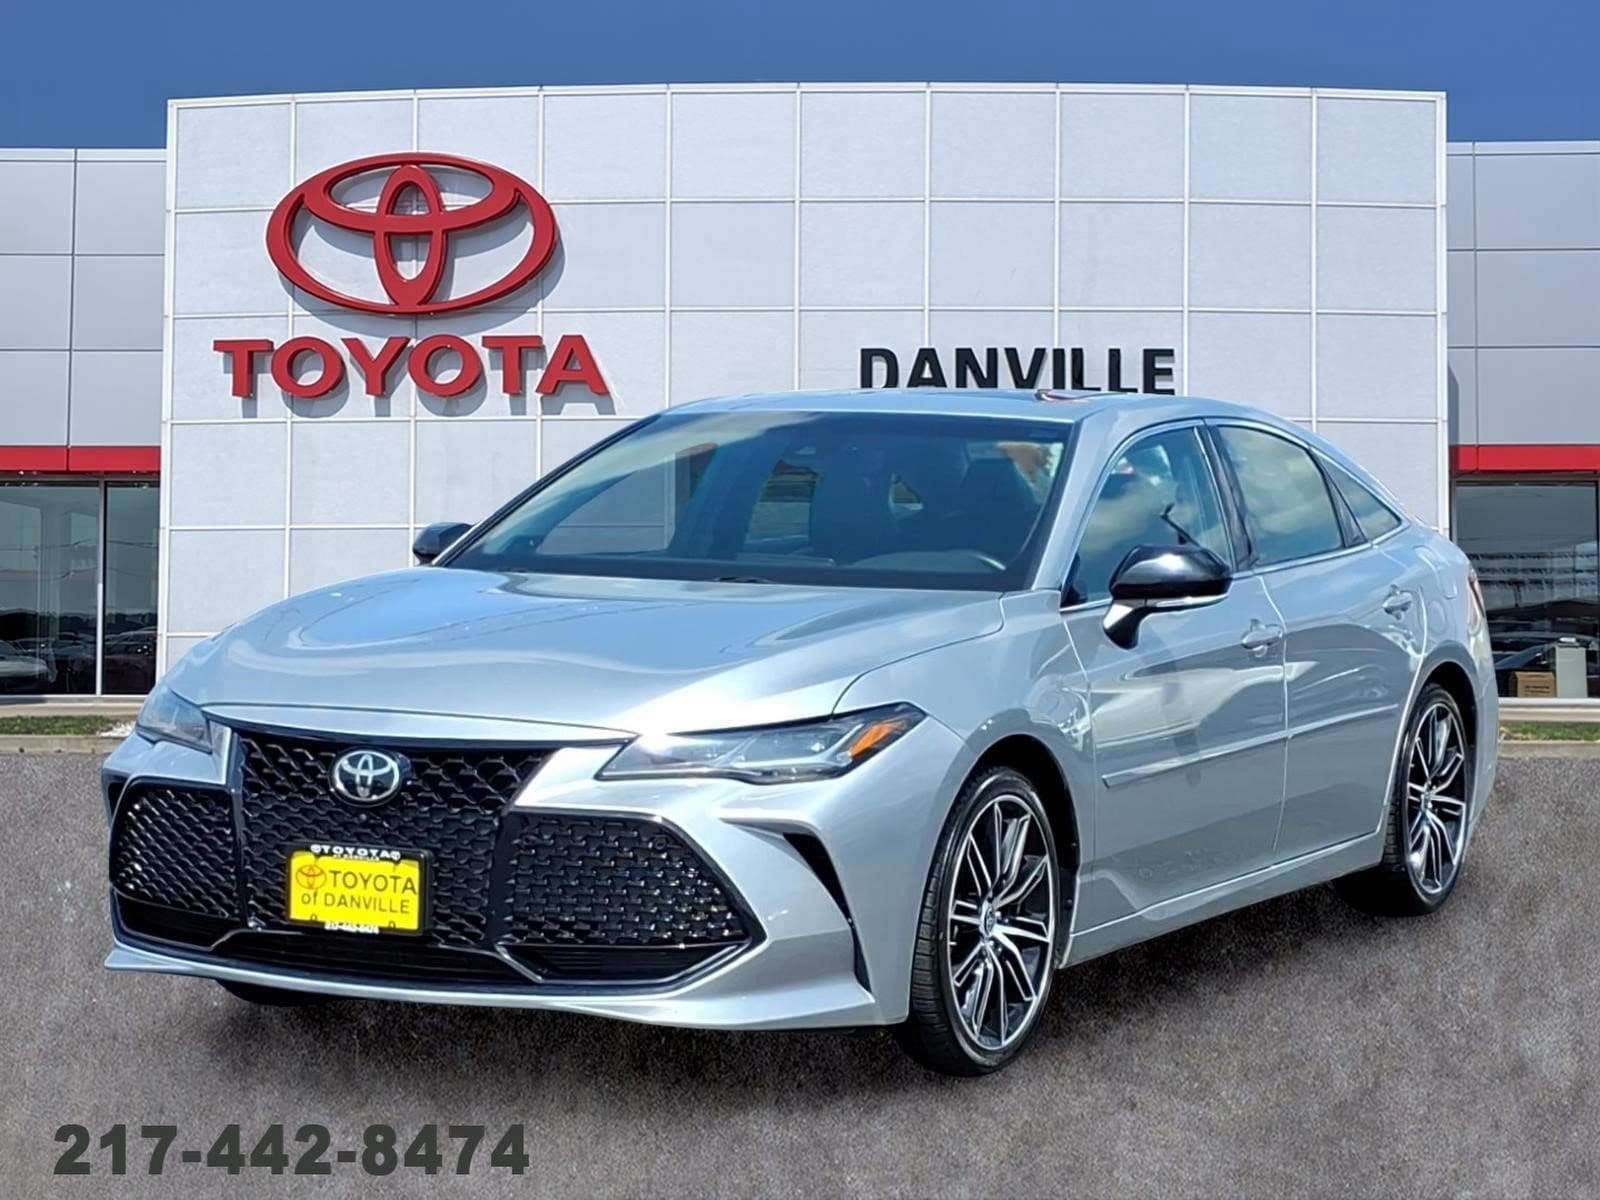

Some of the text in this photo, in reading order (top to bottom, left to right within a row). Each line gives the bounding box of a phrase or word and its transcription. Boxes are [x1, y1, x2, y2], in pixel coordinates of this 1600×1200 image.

[213, 334, 611, 399] TOYOTA
[859, 347, 1176, 395] DANVILLE
[321, 844, 391, 859] TOYOTA
[329, 869, 417, 895] TOYOTA
[301, 890, 411, 914] of DANVILLE
